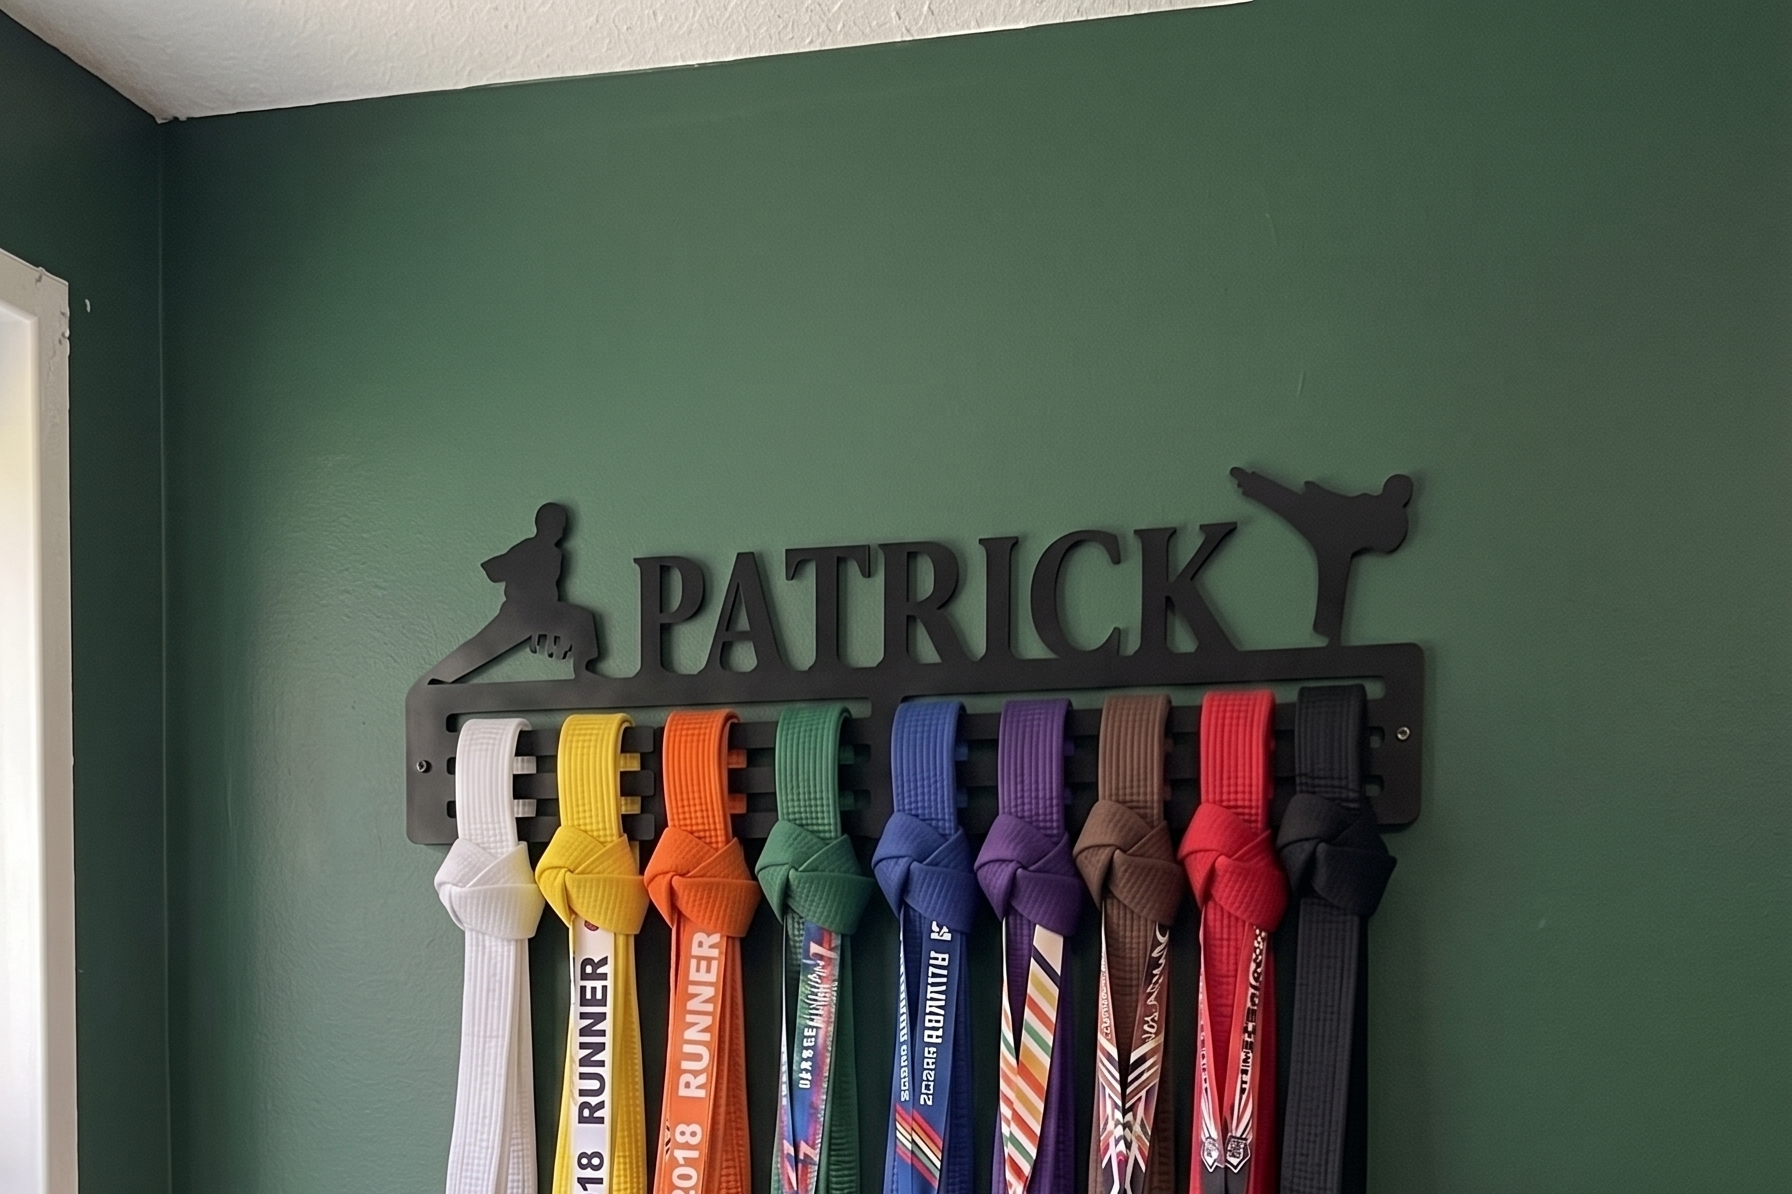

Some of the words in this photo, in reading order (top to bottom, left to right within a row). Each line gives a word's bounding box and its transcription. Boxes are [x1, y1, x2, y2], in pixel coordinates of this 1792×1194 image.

[632, 521, 1238, 675] PATRICK
[577, 955, 610, 1126] RUNNER
[677, 931, 722, 1099] RUNNER
